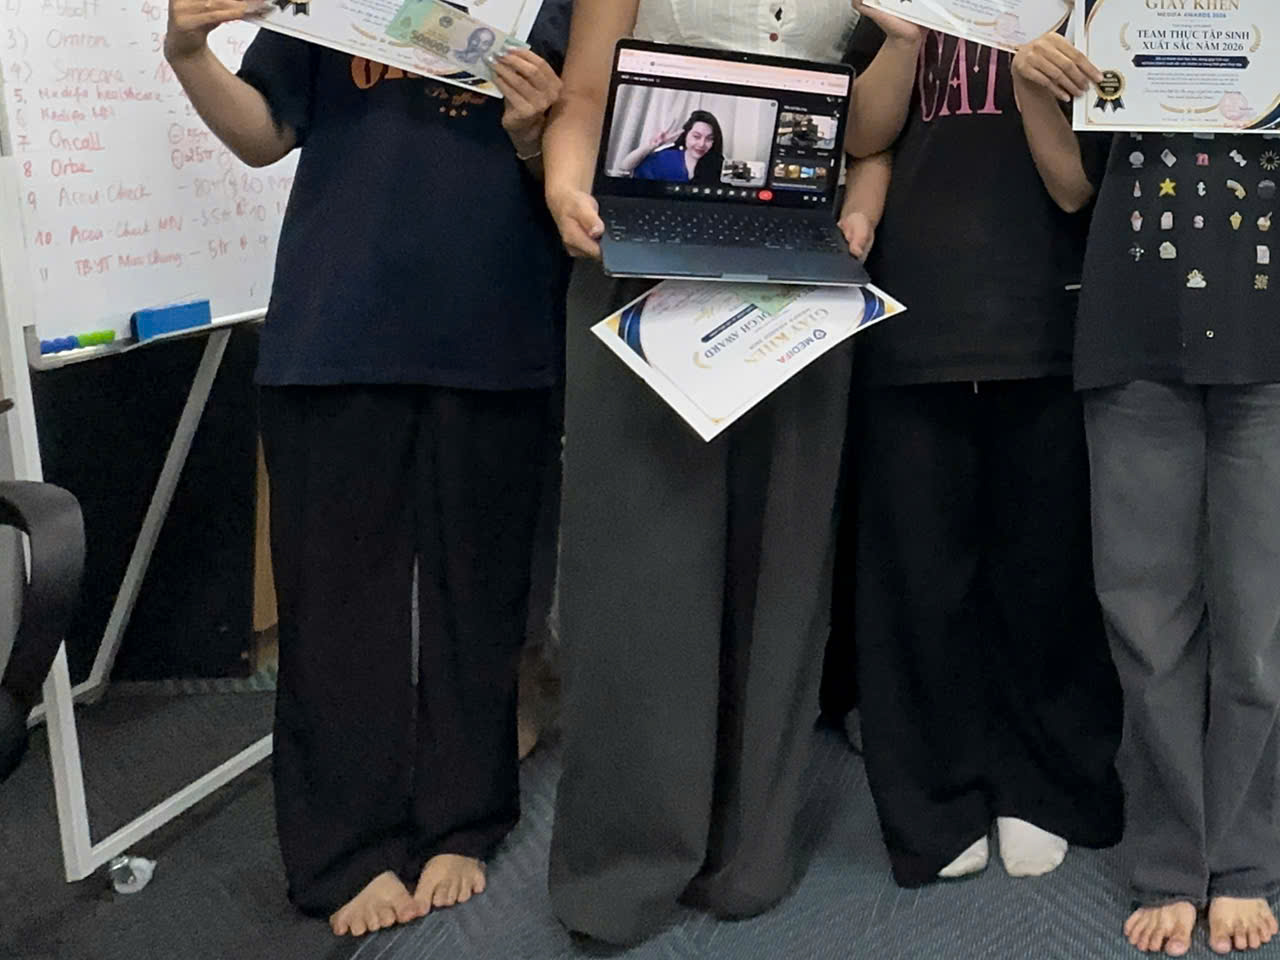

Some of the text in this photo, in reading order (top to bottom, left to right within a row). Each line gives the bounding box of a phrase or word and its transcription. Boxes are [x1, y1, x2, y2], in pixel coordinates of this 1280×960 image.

[1138, 28, 1250, 40] TEAM THỰC TẬP SINH
[1143, 40, 1244, 52] XUẤT SẮC NĂM 2026
[23, 160, 32, 177] 8
[704, 330, 740, 359] AWARD
[776, 336, 815, 364] MEDIFA
